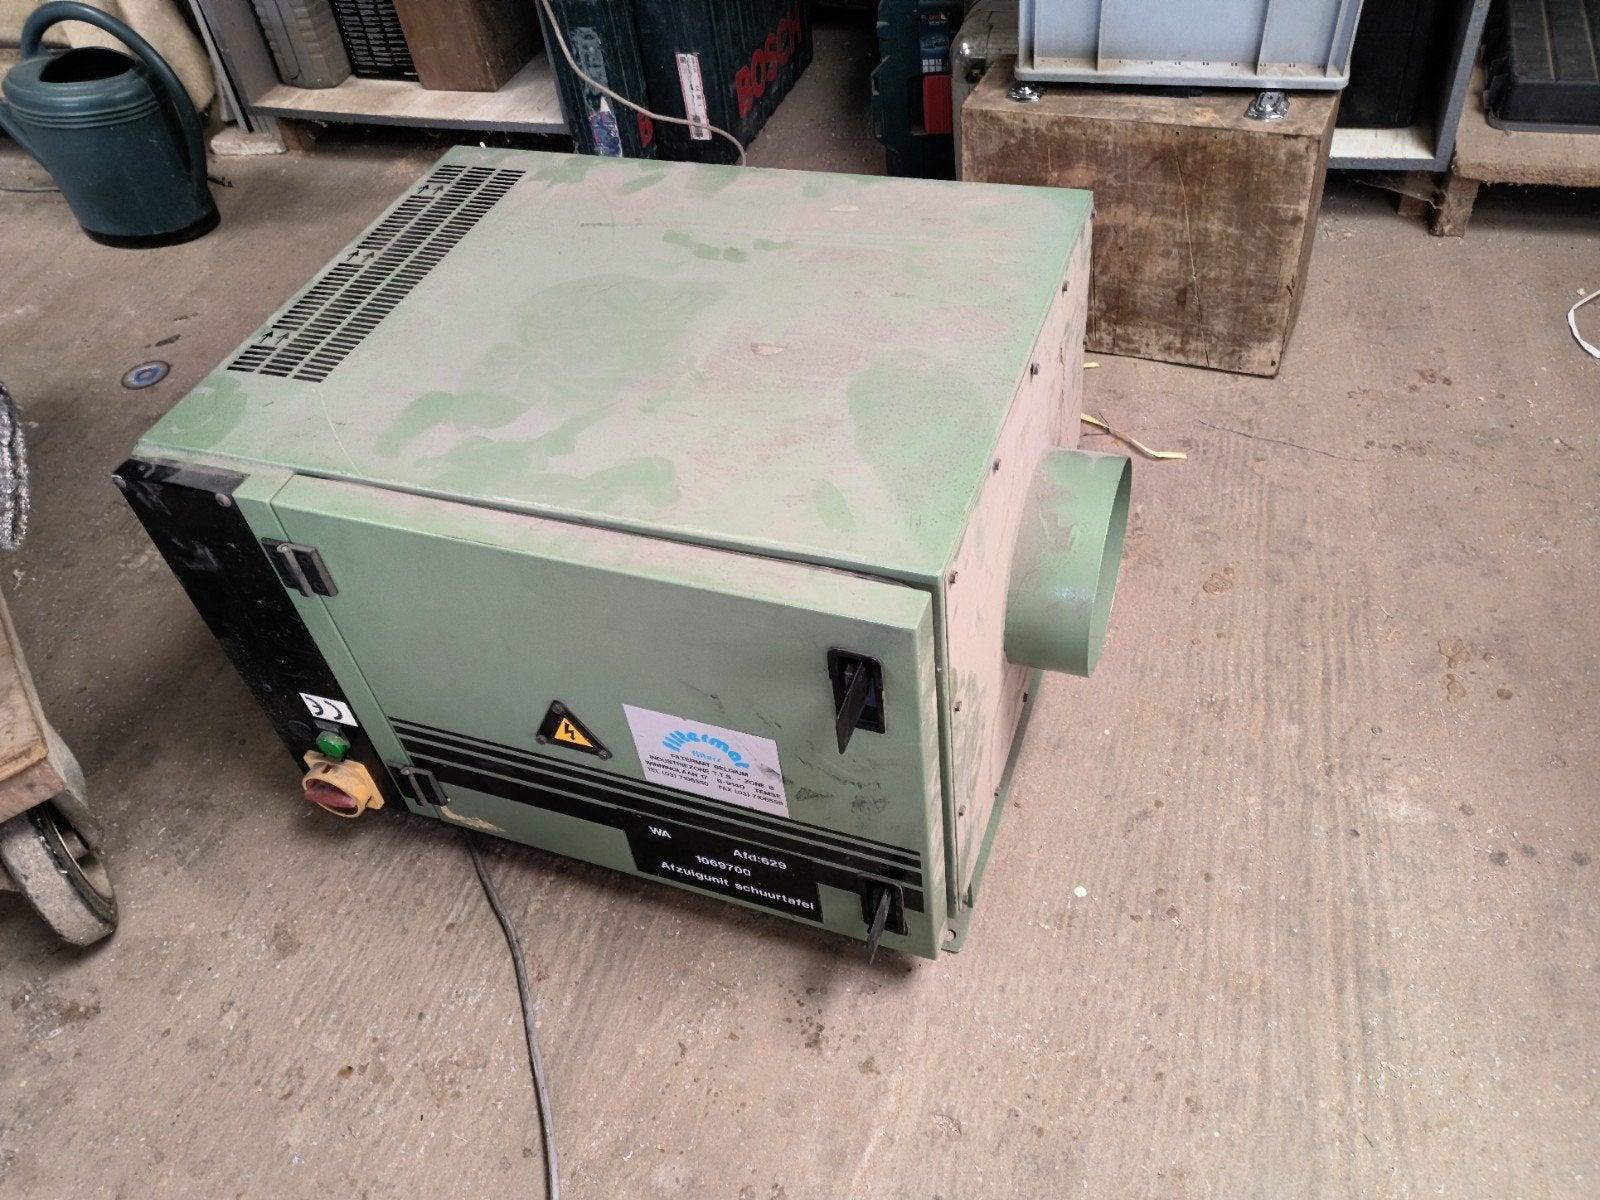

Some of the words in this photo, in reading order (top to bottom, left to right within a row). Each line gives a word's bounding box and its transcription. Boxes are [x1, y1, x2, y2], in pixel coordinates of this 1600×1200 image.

[735, 1, 803, 119] BOSCH
[648, 754, 709, 774] INDUSTRIEZONE
[744, 778, 765, 788] ZONE
[713, 764, 748, 777] BELGIUM
[754, 788, 781, 799] TEMSE
[649, 825, 672, 839] WA
[696, 855, 752, 876] 1069700
[733, 849, 787, 870] Afd:629
[661, 861, 729, 887] Afzuigunit
[735, 883, 814, 911] schuurtafel
